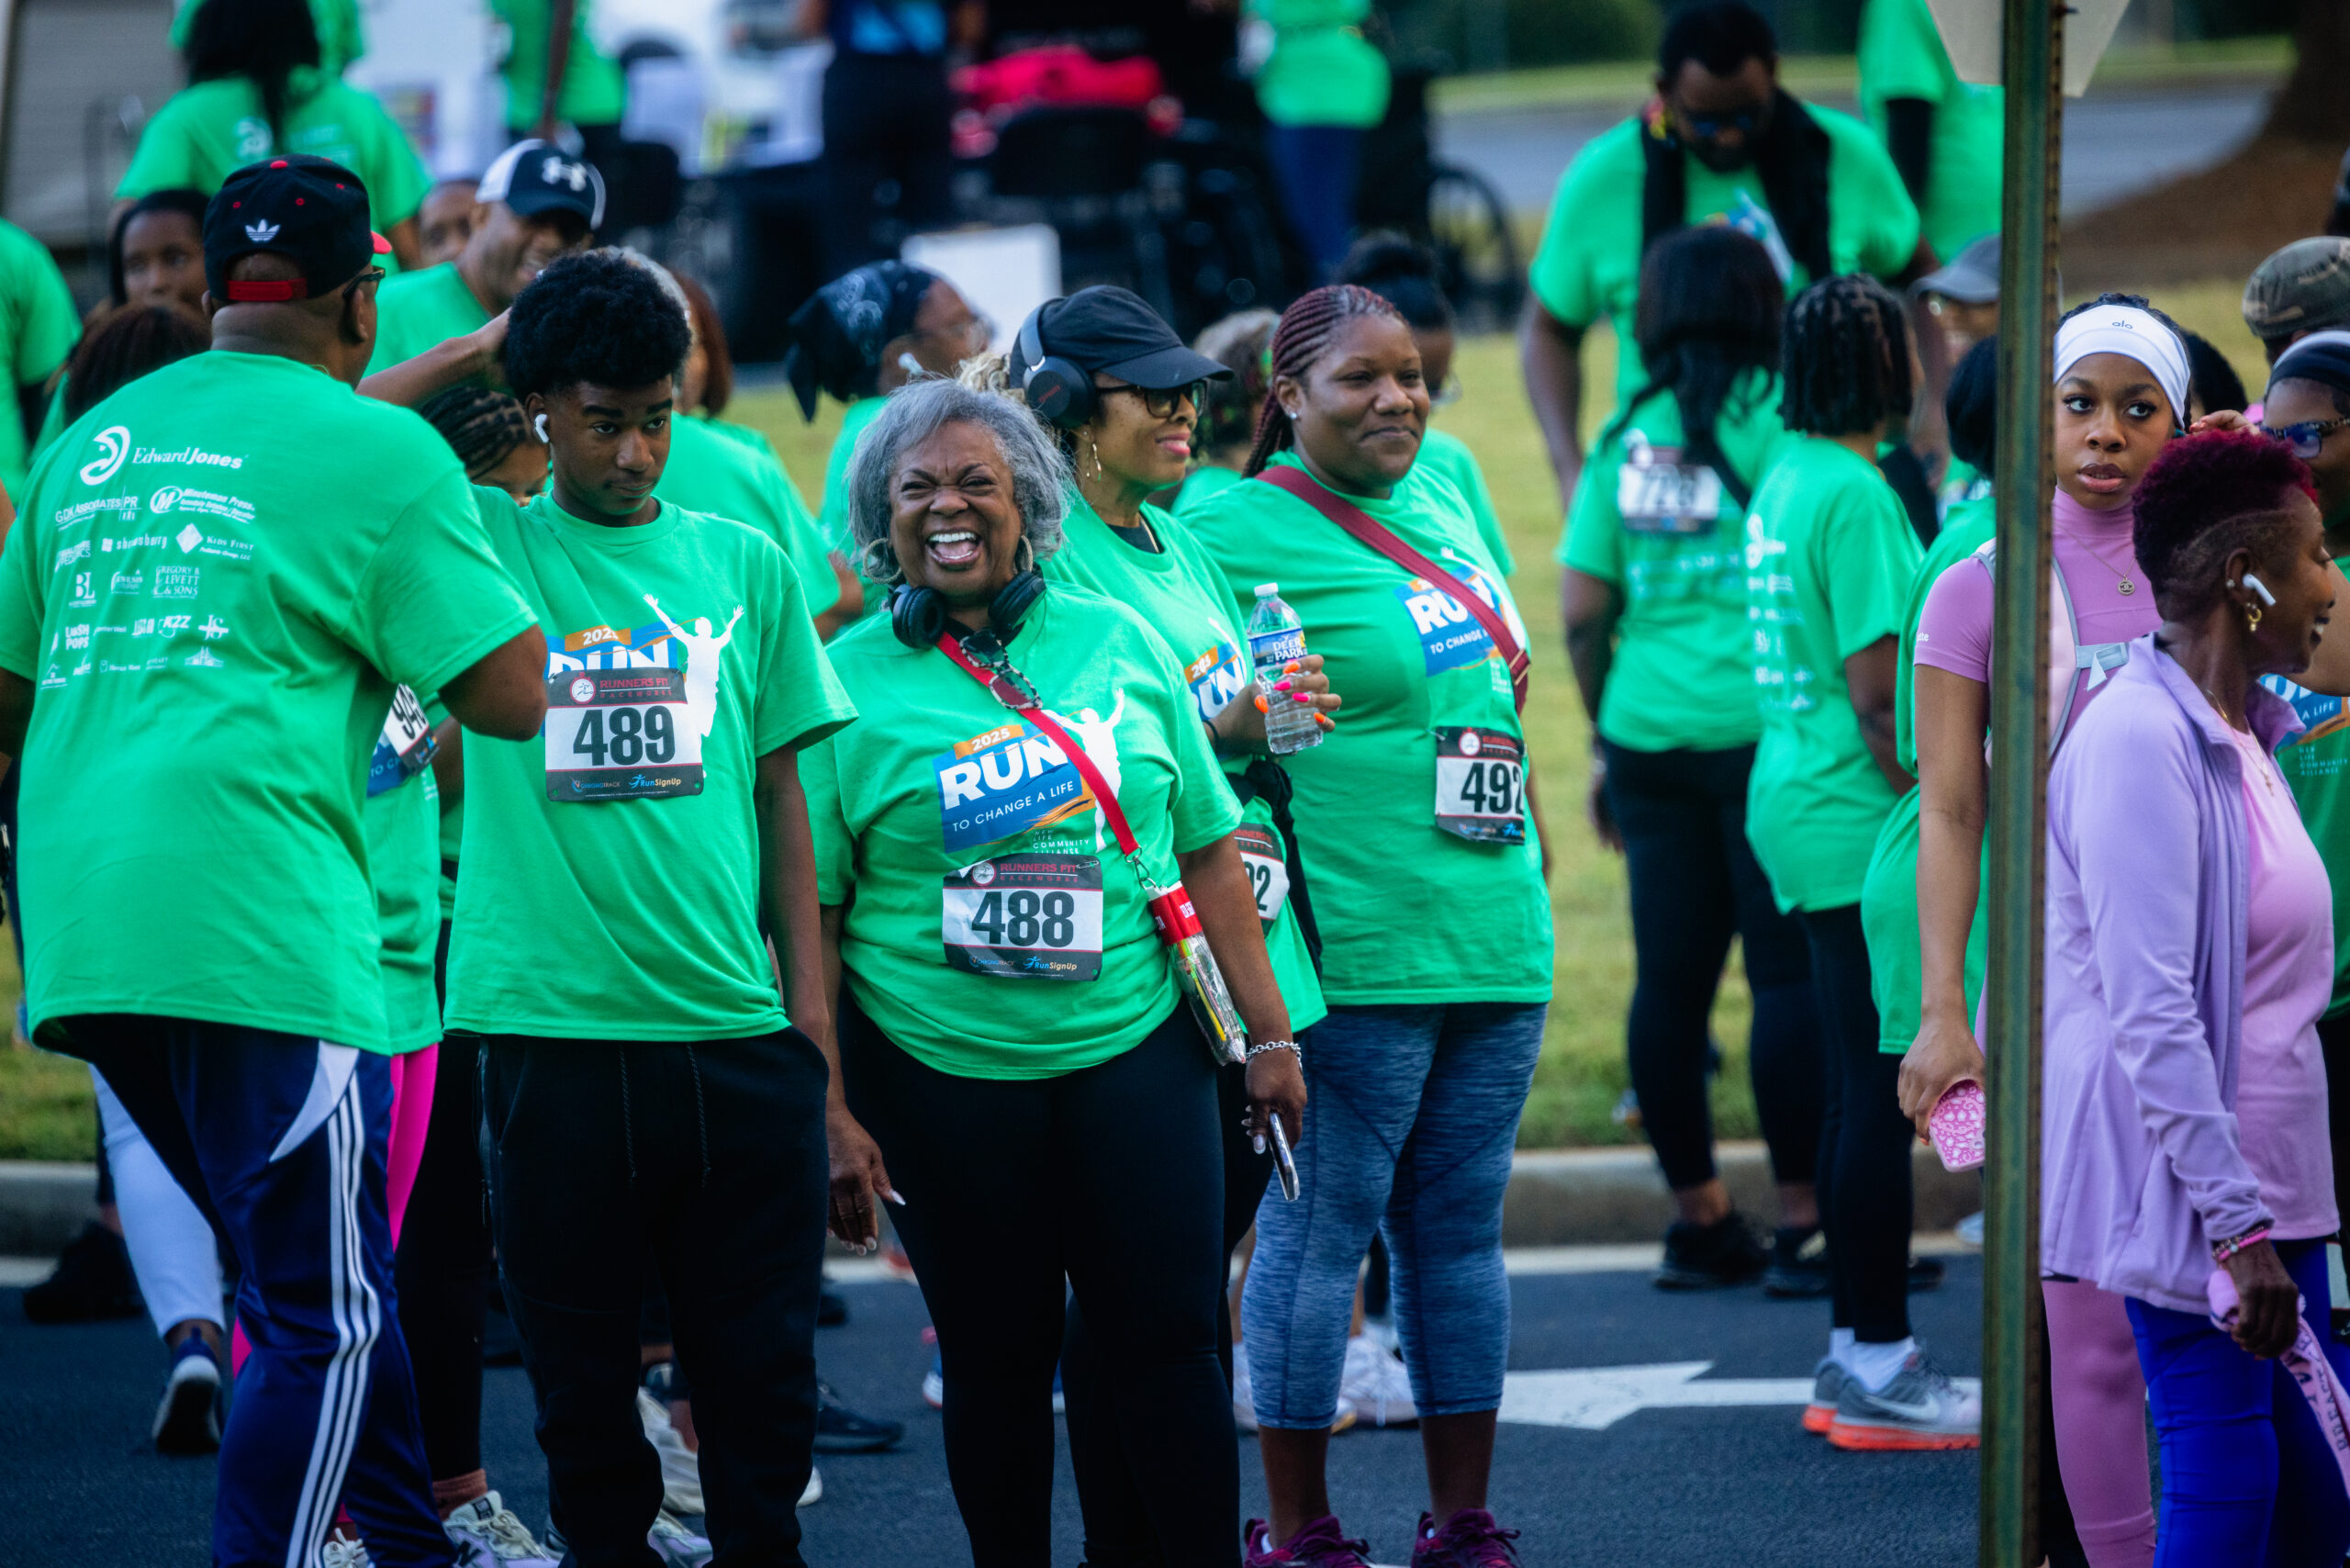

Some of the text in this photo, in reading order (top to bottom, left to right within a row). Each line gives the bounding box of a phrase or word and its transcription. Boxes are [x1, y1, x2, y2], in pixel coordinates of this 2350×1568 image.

[2111, 319, 2133, 330] alo
[131, 447, 242, 469] Edward Jones
[1272, 637, 1301, 651] DEER
[1274, 646, 1304, 661] PARK
[599, 678, 668, 689] RUNNERS FIT
[2302, 700, 2334, 721] A LIFE
[573, 705, 676, 767] 489
[971, 728, 1011, 752] 2025
[939, 734, 1069, 811] RUN
[640, 778, 681, 788] RunSignUp
[1460, 762, 1524, 815] 492
[953, 780, 1074, 832] TO CHANGE A LIFE
[1033, 839, 1090, 849] COMMUNITY
[1001, 863, 1078, 873] RUNNERS FIT
[971, 890, 1074, 948] 488
[1035, 961, 1078, 971] RunSignUp
